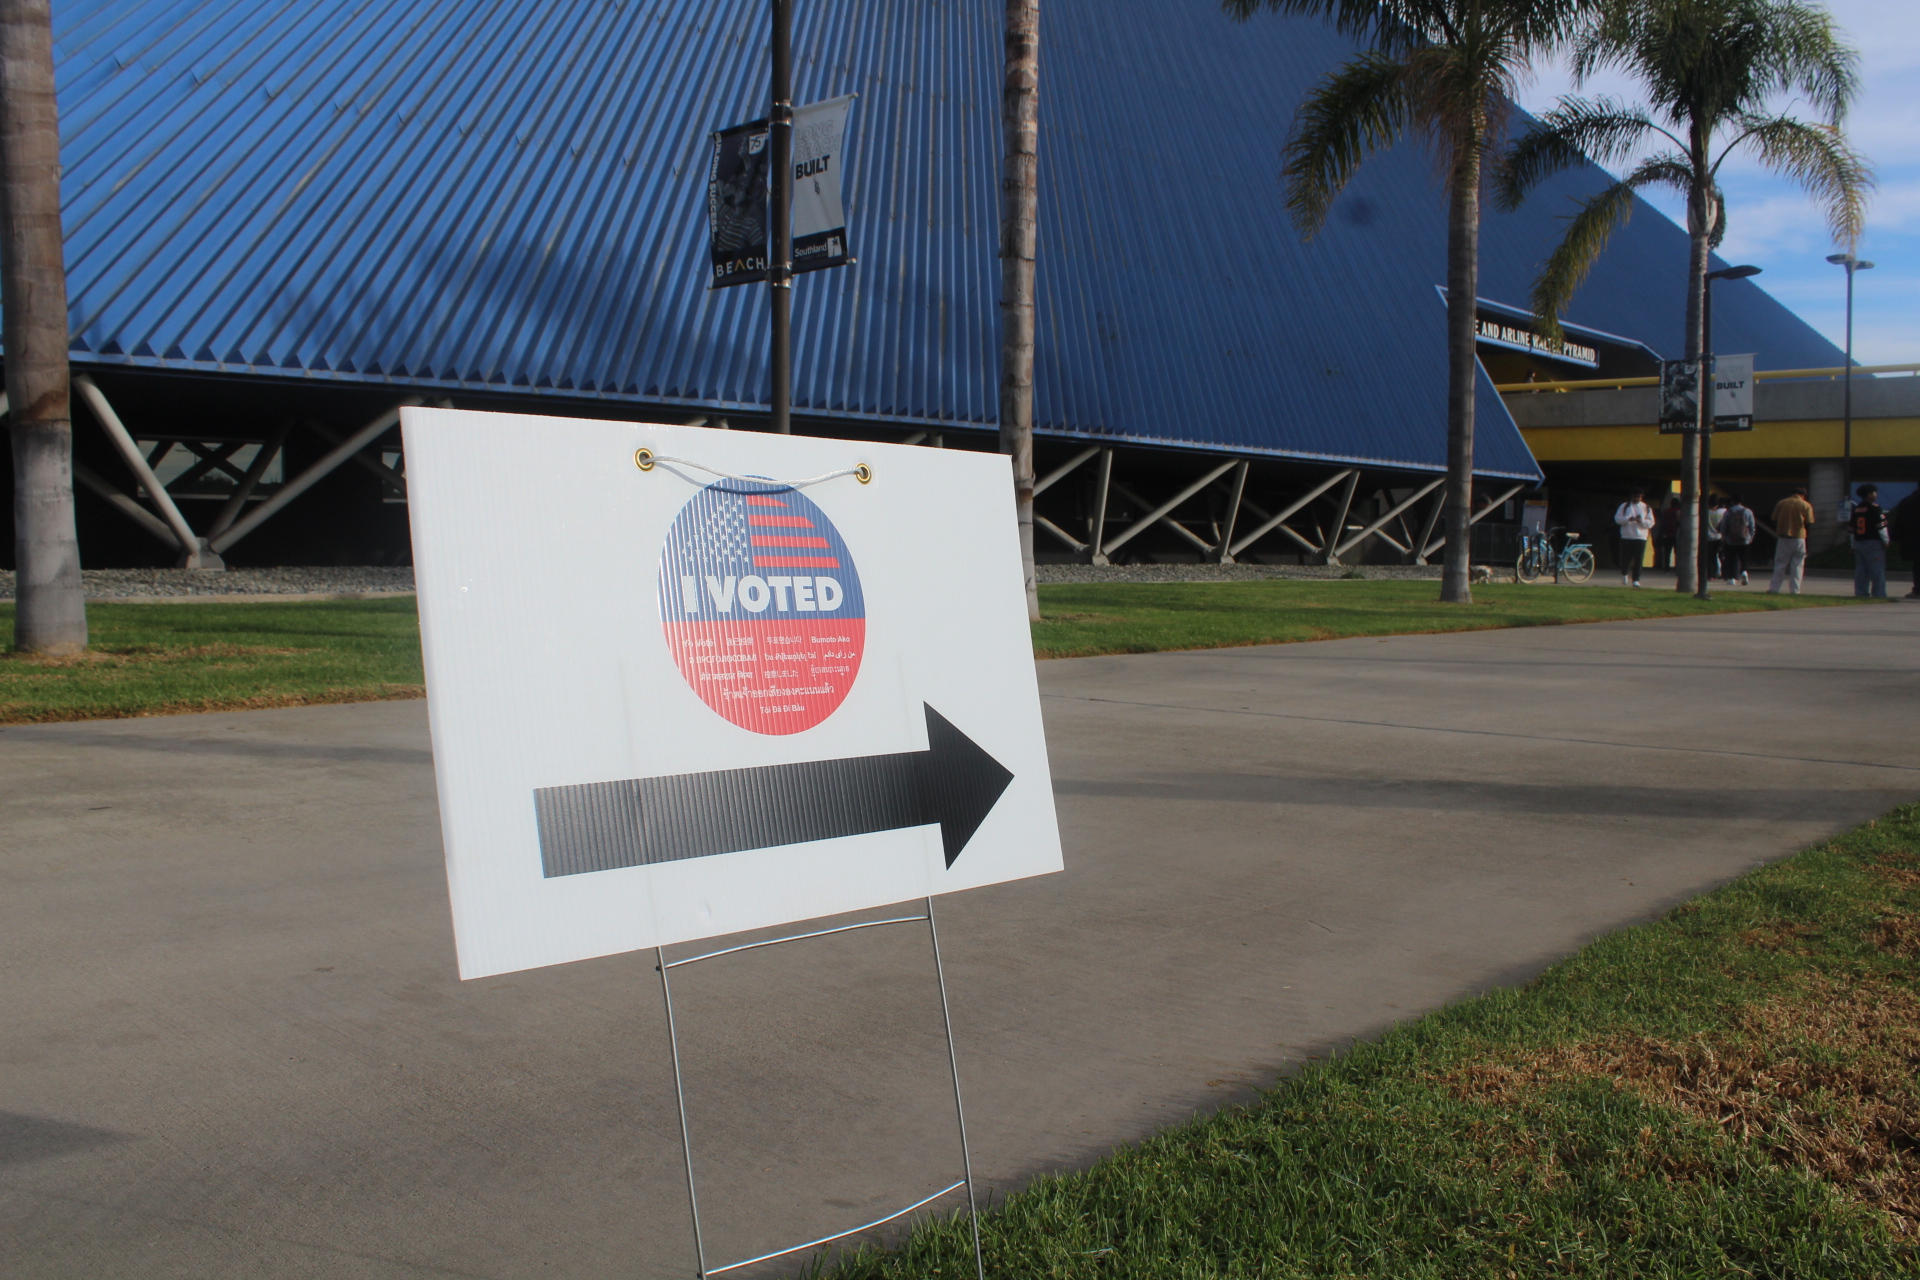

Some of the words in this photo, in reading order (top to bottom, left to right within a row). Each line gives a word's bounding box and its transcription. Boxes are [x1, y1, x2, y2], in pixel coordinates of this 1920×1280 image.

[750, 136, 761, 150] 75
[795, 120, 833, 145] LONG
[710, 132, 722, 181] BUILDING
[795, 134, 840, 163] BEACH
[795, 154, 831, 180] BUILT
[795, 242, 827, 258] Southland
[716, 258, 766, 278] BEACH
[1481, 321, 1500, 339] AND
[1501, 326, 1531, 346] ARLINE
[1563, 342, 1596, 362] PYRAMID
[1716, 381, 1745, 390] BUILT
[1857, 516, 1866, 535] 9
[682, 575, 699, 613] I
[704, 574, 844, 613] VOTED
[811, 636, 837, 644] Bumoto
[837, 635, 851, 643] Ako
